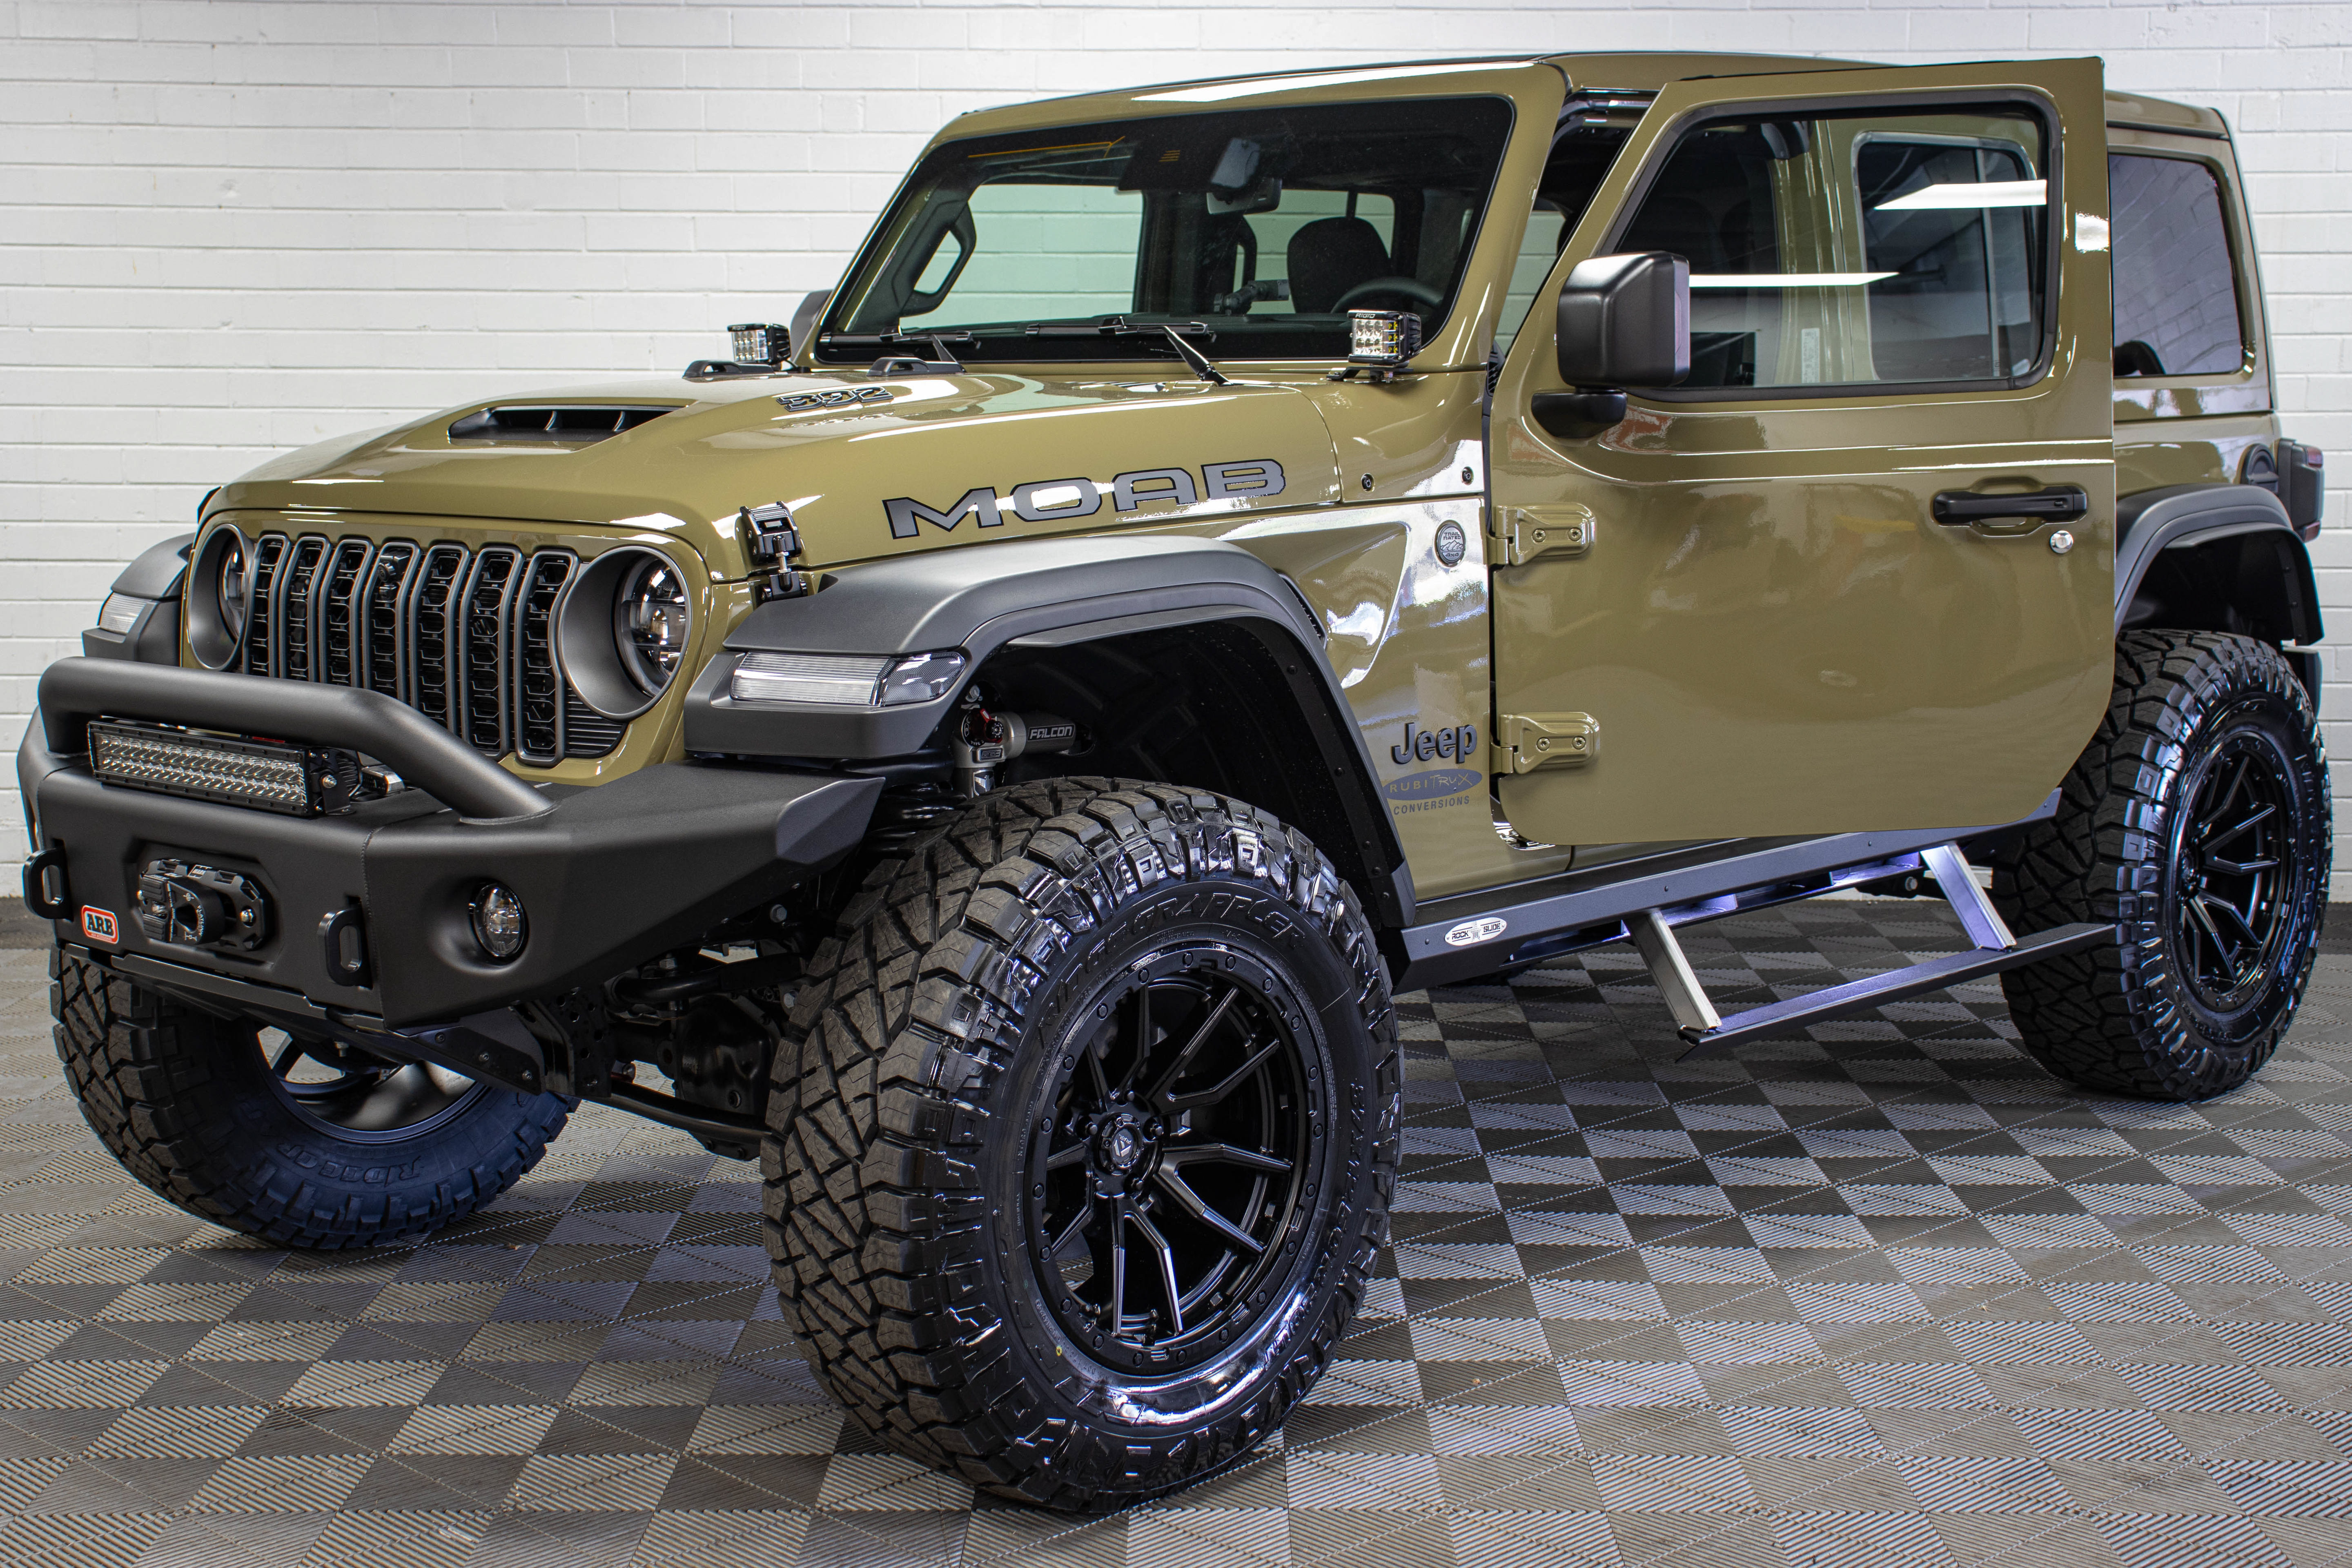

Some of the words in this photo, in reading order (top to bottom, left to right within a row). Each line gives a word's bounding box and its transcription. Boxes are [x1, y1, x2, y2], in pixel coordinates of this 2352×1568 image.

[776, 387, 894, 412] 392
[882, 458, 1286, 540] MOAB
[1029, 726, 1073, 739] FALCON
[1391, 722, 1477, 764] Jeep
[1393, 796, 1470, 815] CONVERSIONS
[87, 913, 114, 936] ARB
[1132, 893, 1306, 949] GRAPPLER
[1452, 930, 1469, 940] ROCK
[1483, 922, 1501, 933] SLIDE
[1119, 1134, 1132, 1145] FUEL
